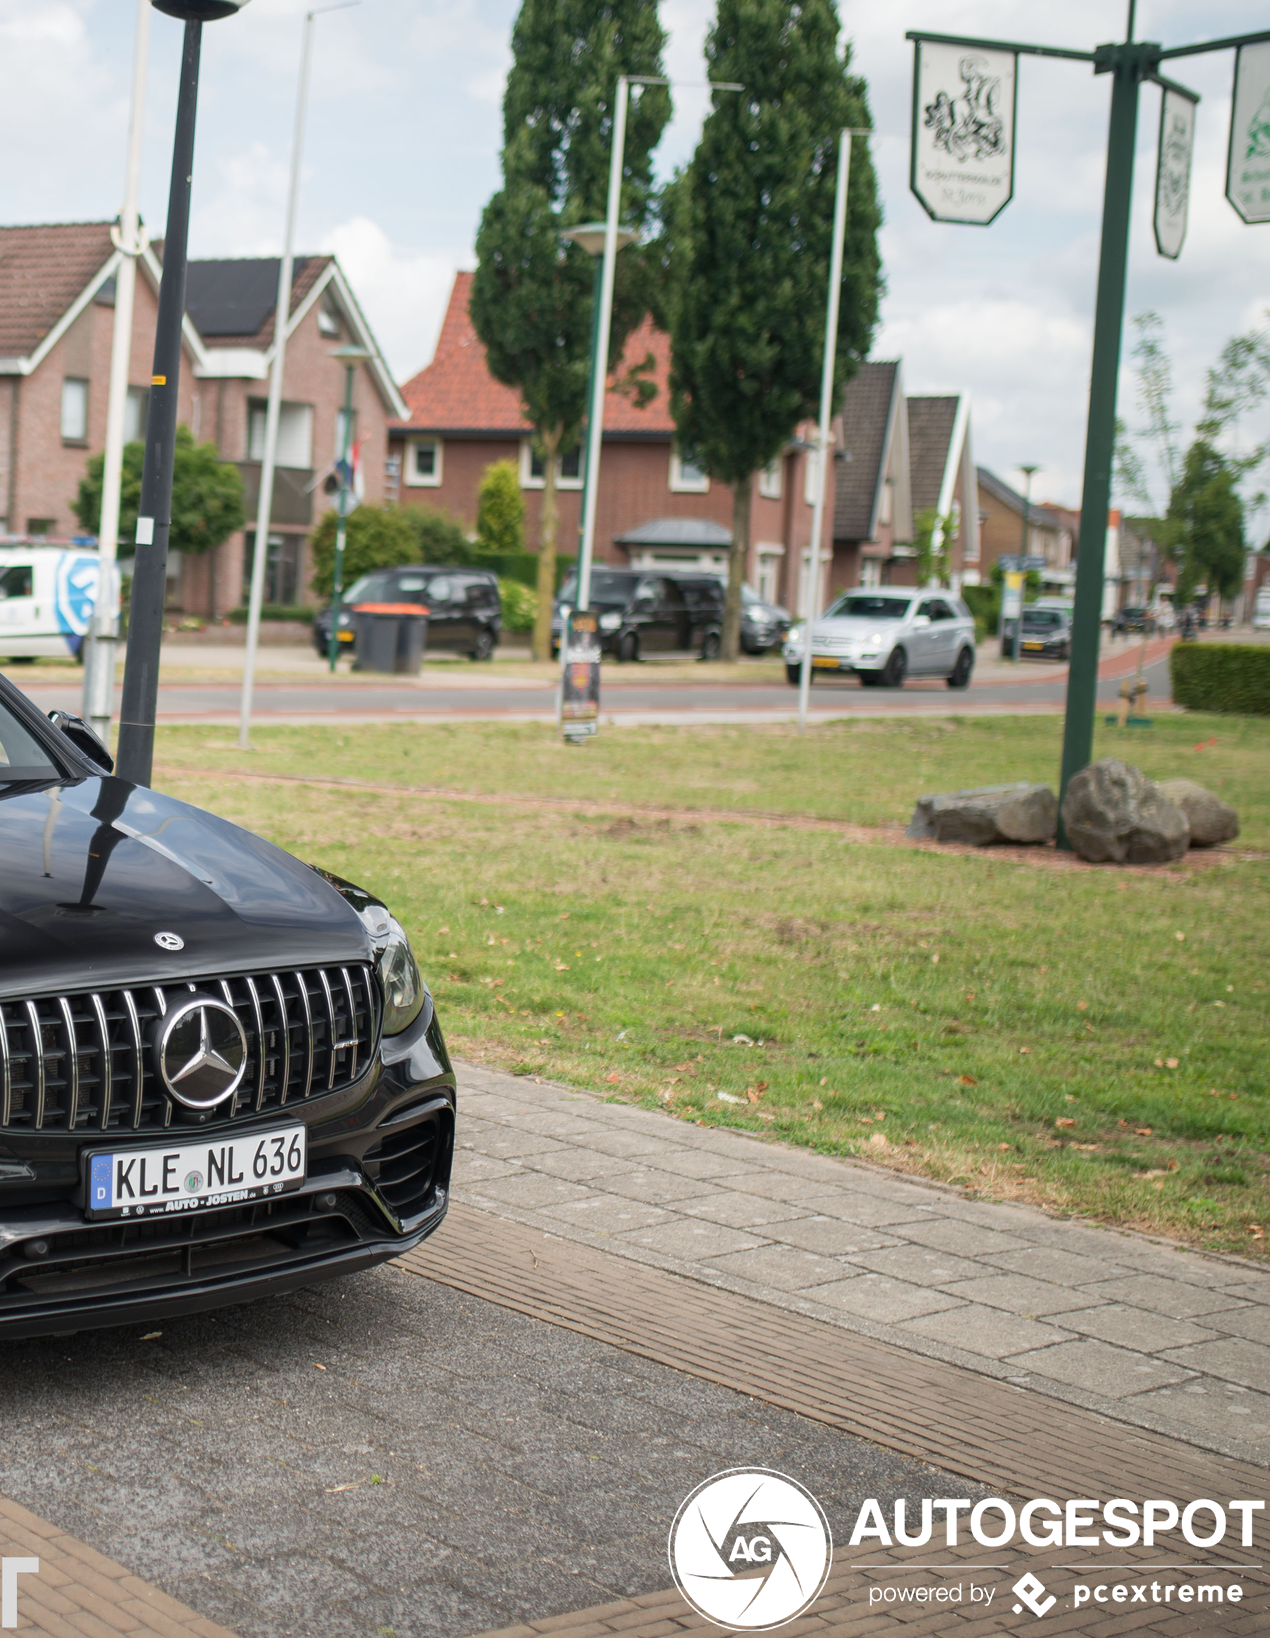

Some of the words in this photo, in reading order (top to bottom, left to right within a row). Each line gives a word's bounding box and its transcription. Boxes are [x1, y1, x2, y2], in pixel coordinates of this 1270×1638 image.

[116, 1153, 180, 1200] KLE
[207, 1146, 244, 1188] NL
[253, 1133, 301, 1179] 636
[97, 1187, 106, 1199] D
